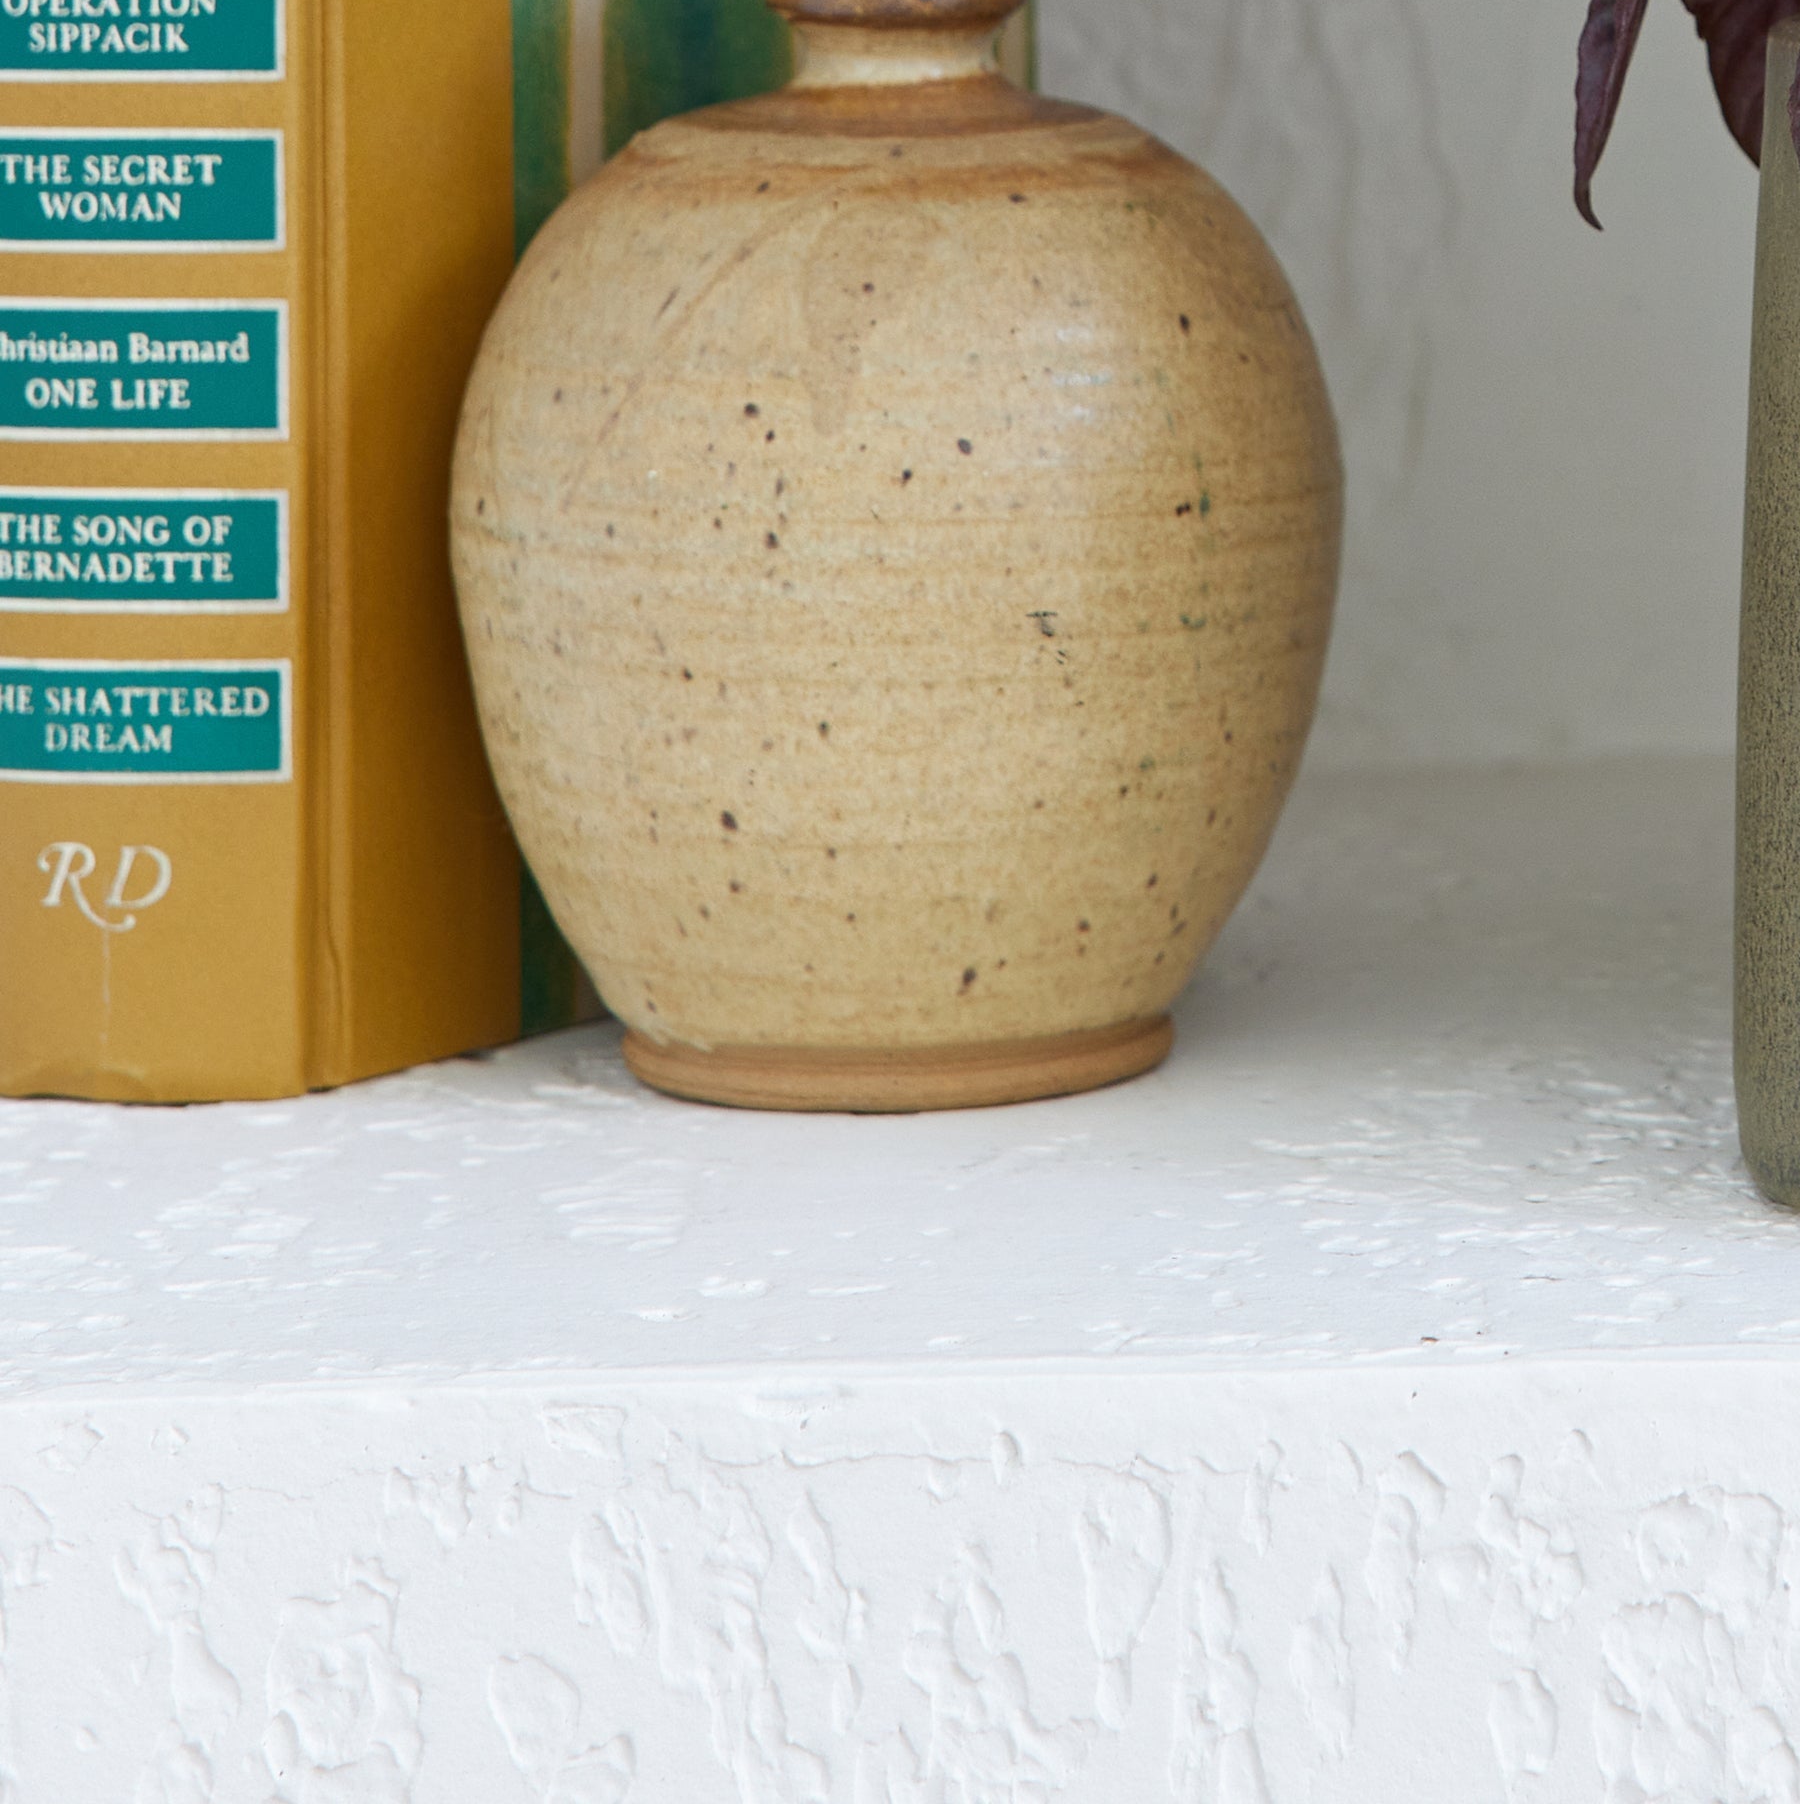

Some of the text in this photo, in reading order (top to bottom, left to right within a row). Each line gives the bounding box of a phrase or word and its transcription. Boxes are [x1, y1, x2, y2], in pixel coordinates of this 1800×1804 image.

[28, 22, 190, 53] SIPPACIK
[0, 154, 223, 186] THE SECRET
[38, 191, 182, 222] WOMAN
[128, 332, 250, 364] Barnard
[25, 378, 191, 410] ONE LIFE
[0, 513, 233, 546] THE SONG OF
[0, 551, 234, 583] BERNADETTE
[45, 686, 271, 717] SHATTERED
[45, 723, 173, 754] DREAM
